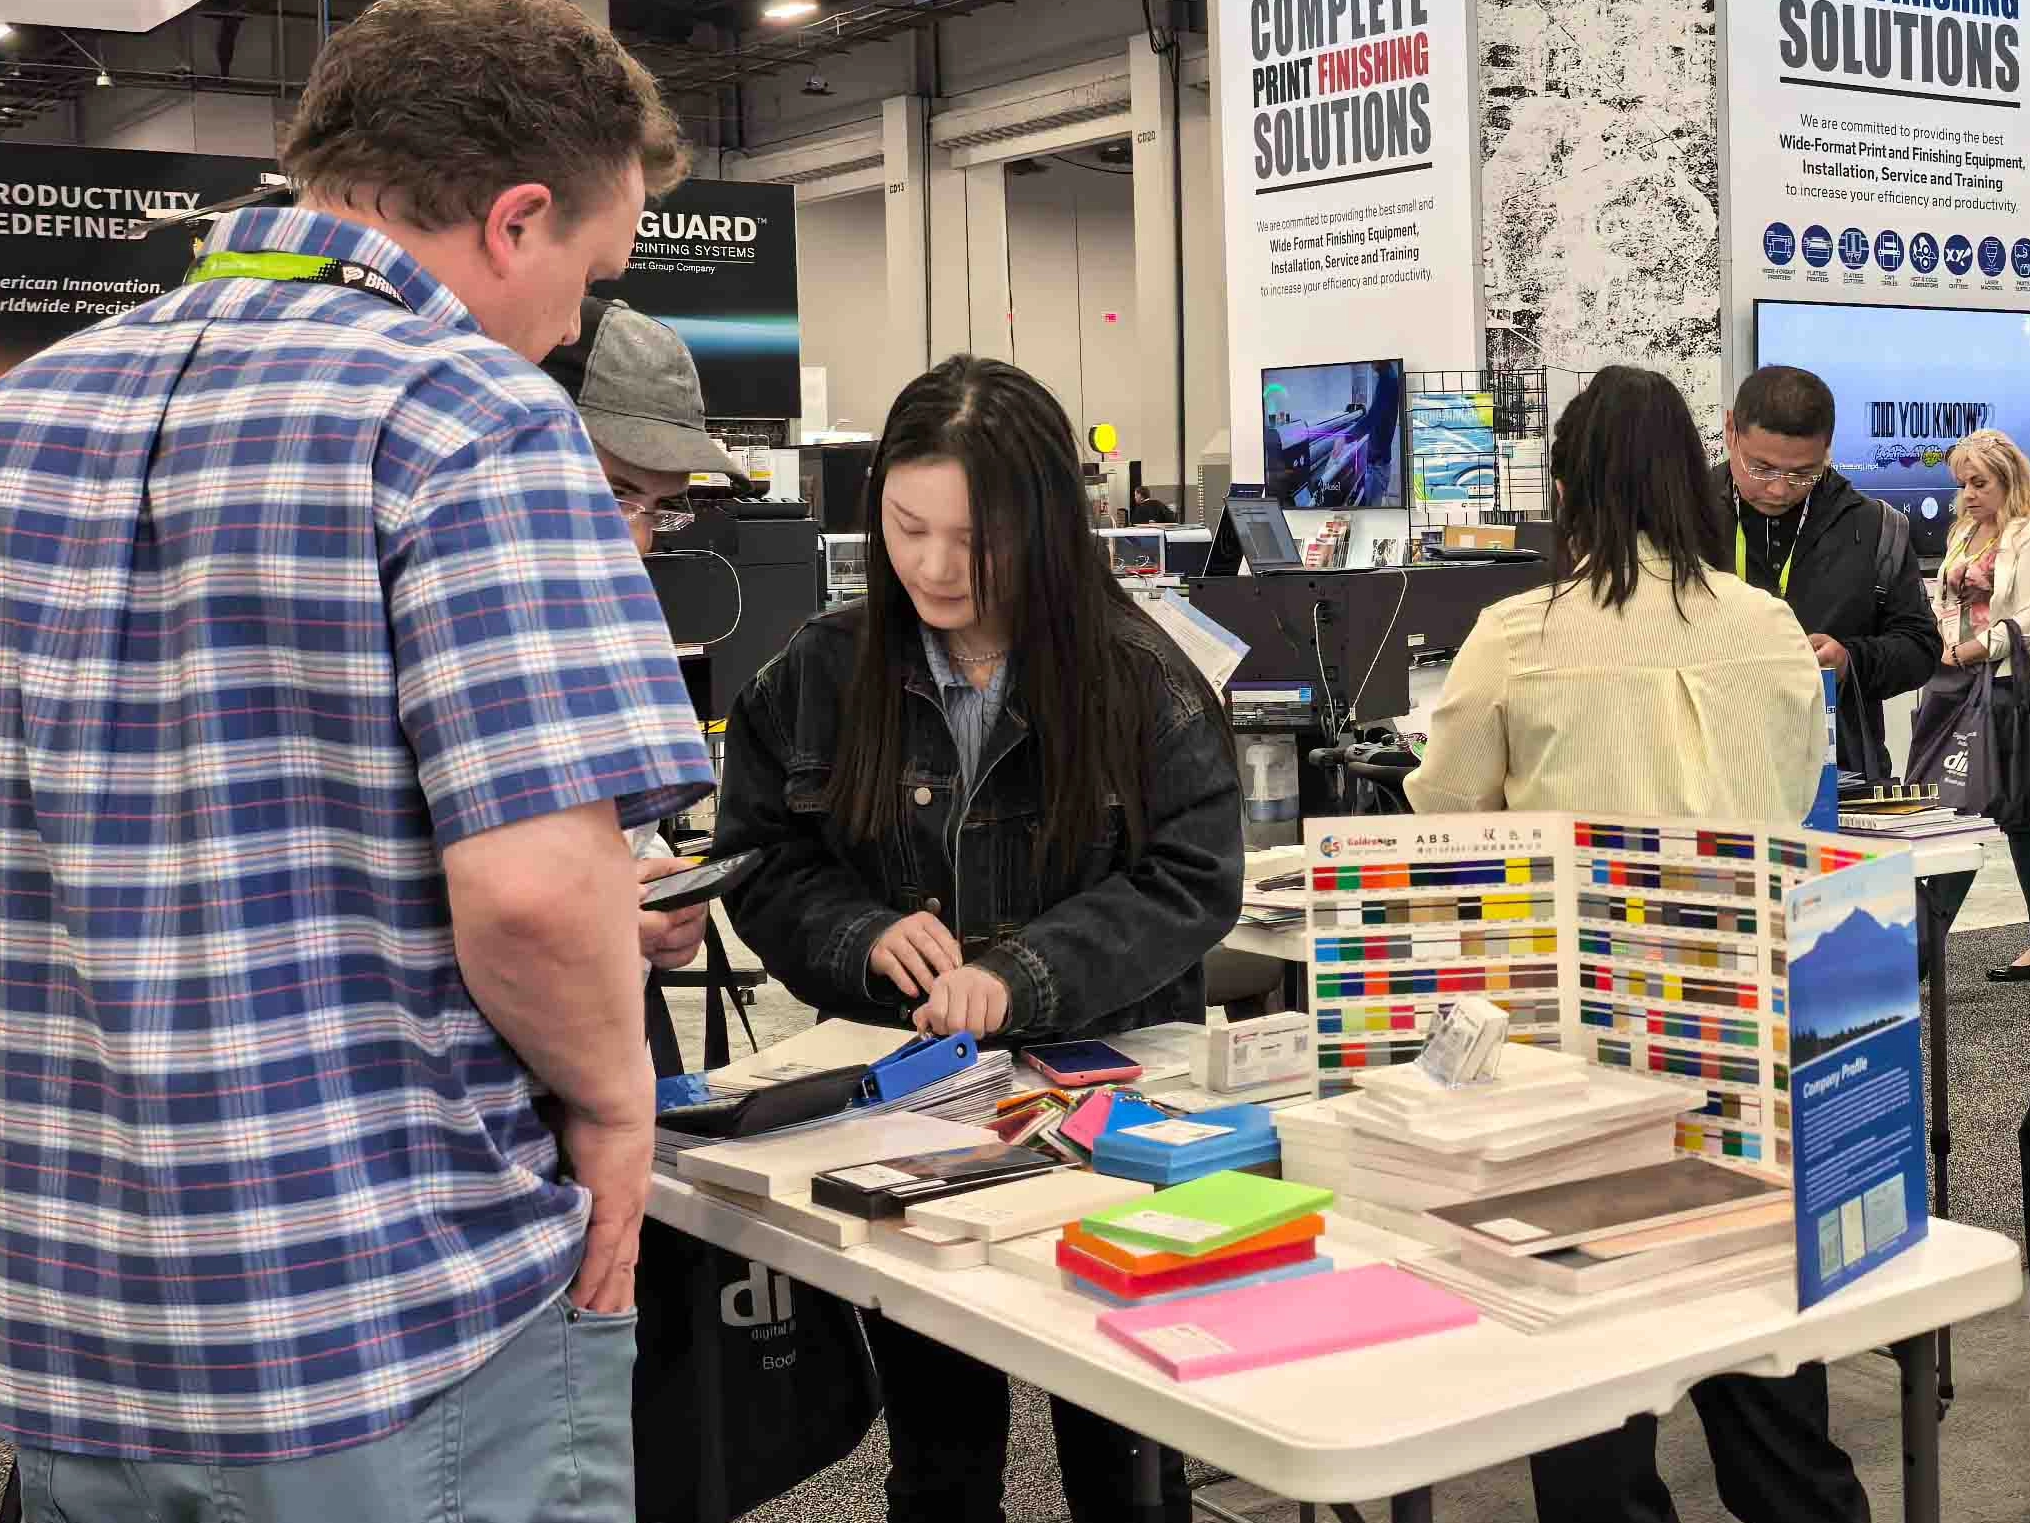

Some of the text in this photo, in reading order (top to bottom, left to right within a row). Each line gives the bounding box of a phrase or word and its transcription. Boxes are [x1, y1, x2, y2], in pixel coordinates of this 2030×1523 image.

[1779, 0, 2019, 92] SOLUTIONS
[1253, 32, 1429, 108] PRINT FINISHING
[1253, 82, 1431, 179] SOLUTIONS
[1800, 113, 2004, 145] We are committed to providing the best
[1780, 133, 2026, 170] Wide-Format Print and Finishing Equipment,
[1802, 159, 2003, 192] Installation, Service and Training
[1785, 183, 1797, 195] to
[1800, 183, 1847, 199] increase
[1850, 189, 1876, 207] your
[1878, 191, 1929, 207] efficiency
[1932, 194, 1951, 208] and
[1257, 197, 1434, 233] We are committed to providing the best small and
[694, 245, 755, 258] SYSTEMS
[1270, 222, 1420, 253] Wide Format Finishing Equipment,
[648, 261, 675, 272] Group
[676, 262, 716, 275] Company
[1271, 245, 1419, 275] Installation, Service and Training
[62, 277, 166, 294] Innovation.
[1260, 286, 1269, 297] to
[1270, 282, 1302, 296] increase
[1303, 281, 1322, 295] your
[1322, 276, 1361, 290] efficiency
[1363, 273, 1378, 286] and
[1871, 402, 1989, 439] DID YOU KNOW?
[1803, 1070, 1840, 1098] Company
